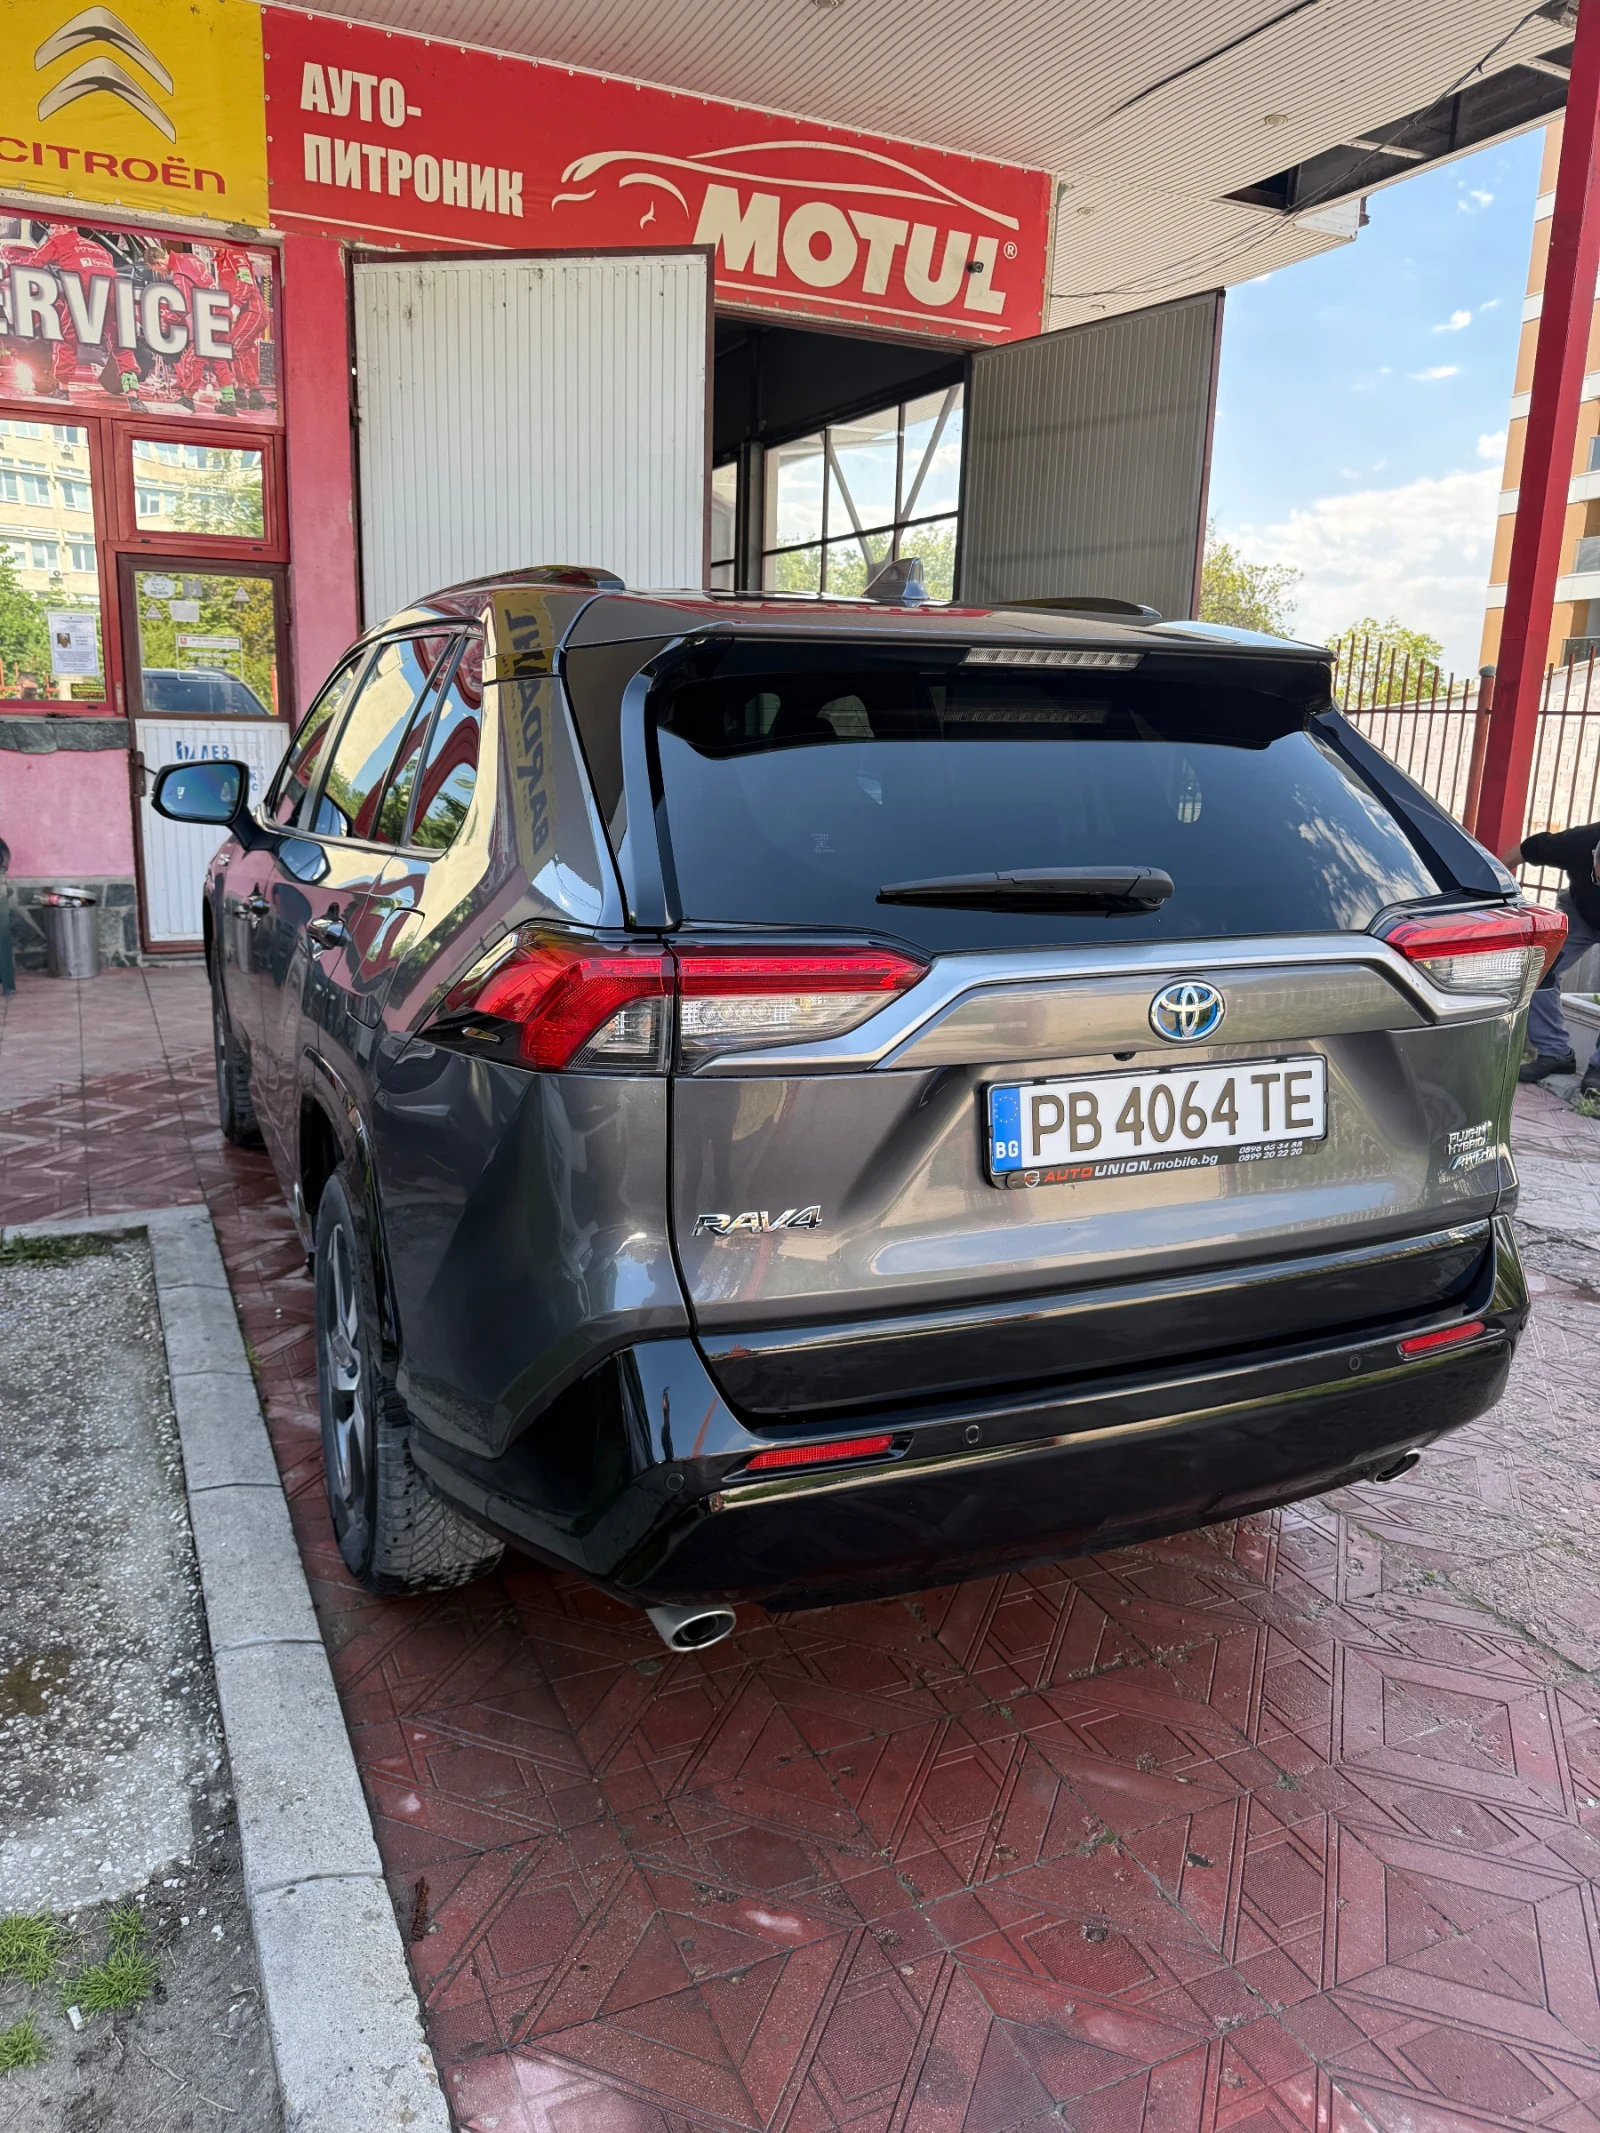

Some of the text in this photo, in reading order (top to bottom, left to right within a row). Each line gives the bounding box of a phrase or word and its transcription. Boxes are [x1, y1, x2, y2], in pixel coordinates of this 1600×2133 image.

[300, 62, 422, 128] АУТО-
[303, 132, 524, 218] ПИТРОНИК
[693, 183, 1007, 315] MOTUL
[0, 264, 234, 359] RVICE
[1031, 1070, 1314, 1156] PB 4064 TE
[1447, 1137, 1486, 1155] HYBRID
[995, 1140, 1019, 1159] BG
[1238, 1147, 1303, 1163] 0899 20 22 20
[691, 1204, 823, 1237] RAV4
